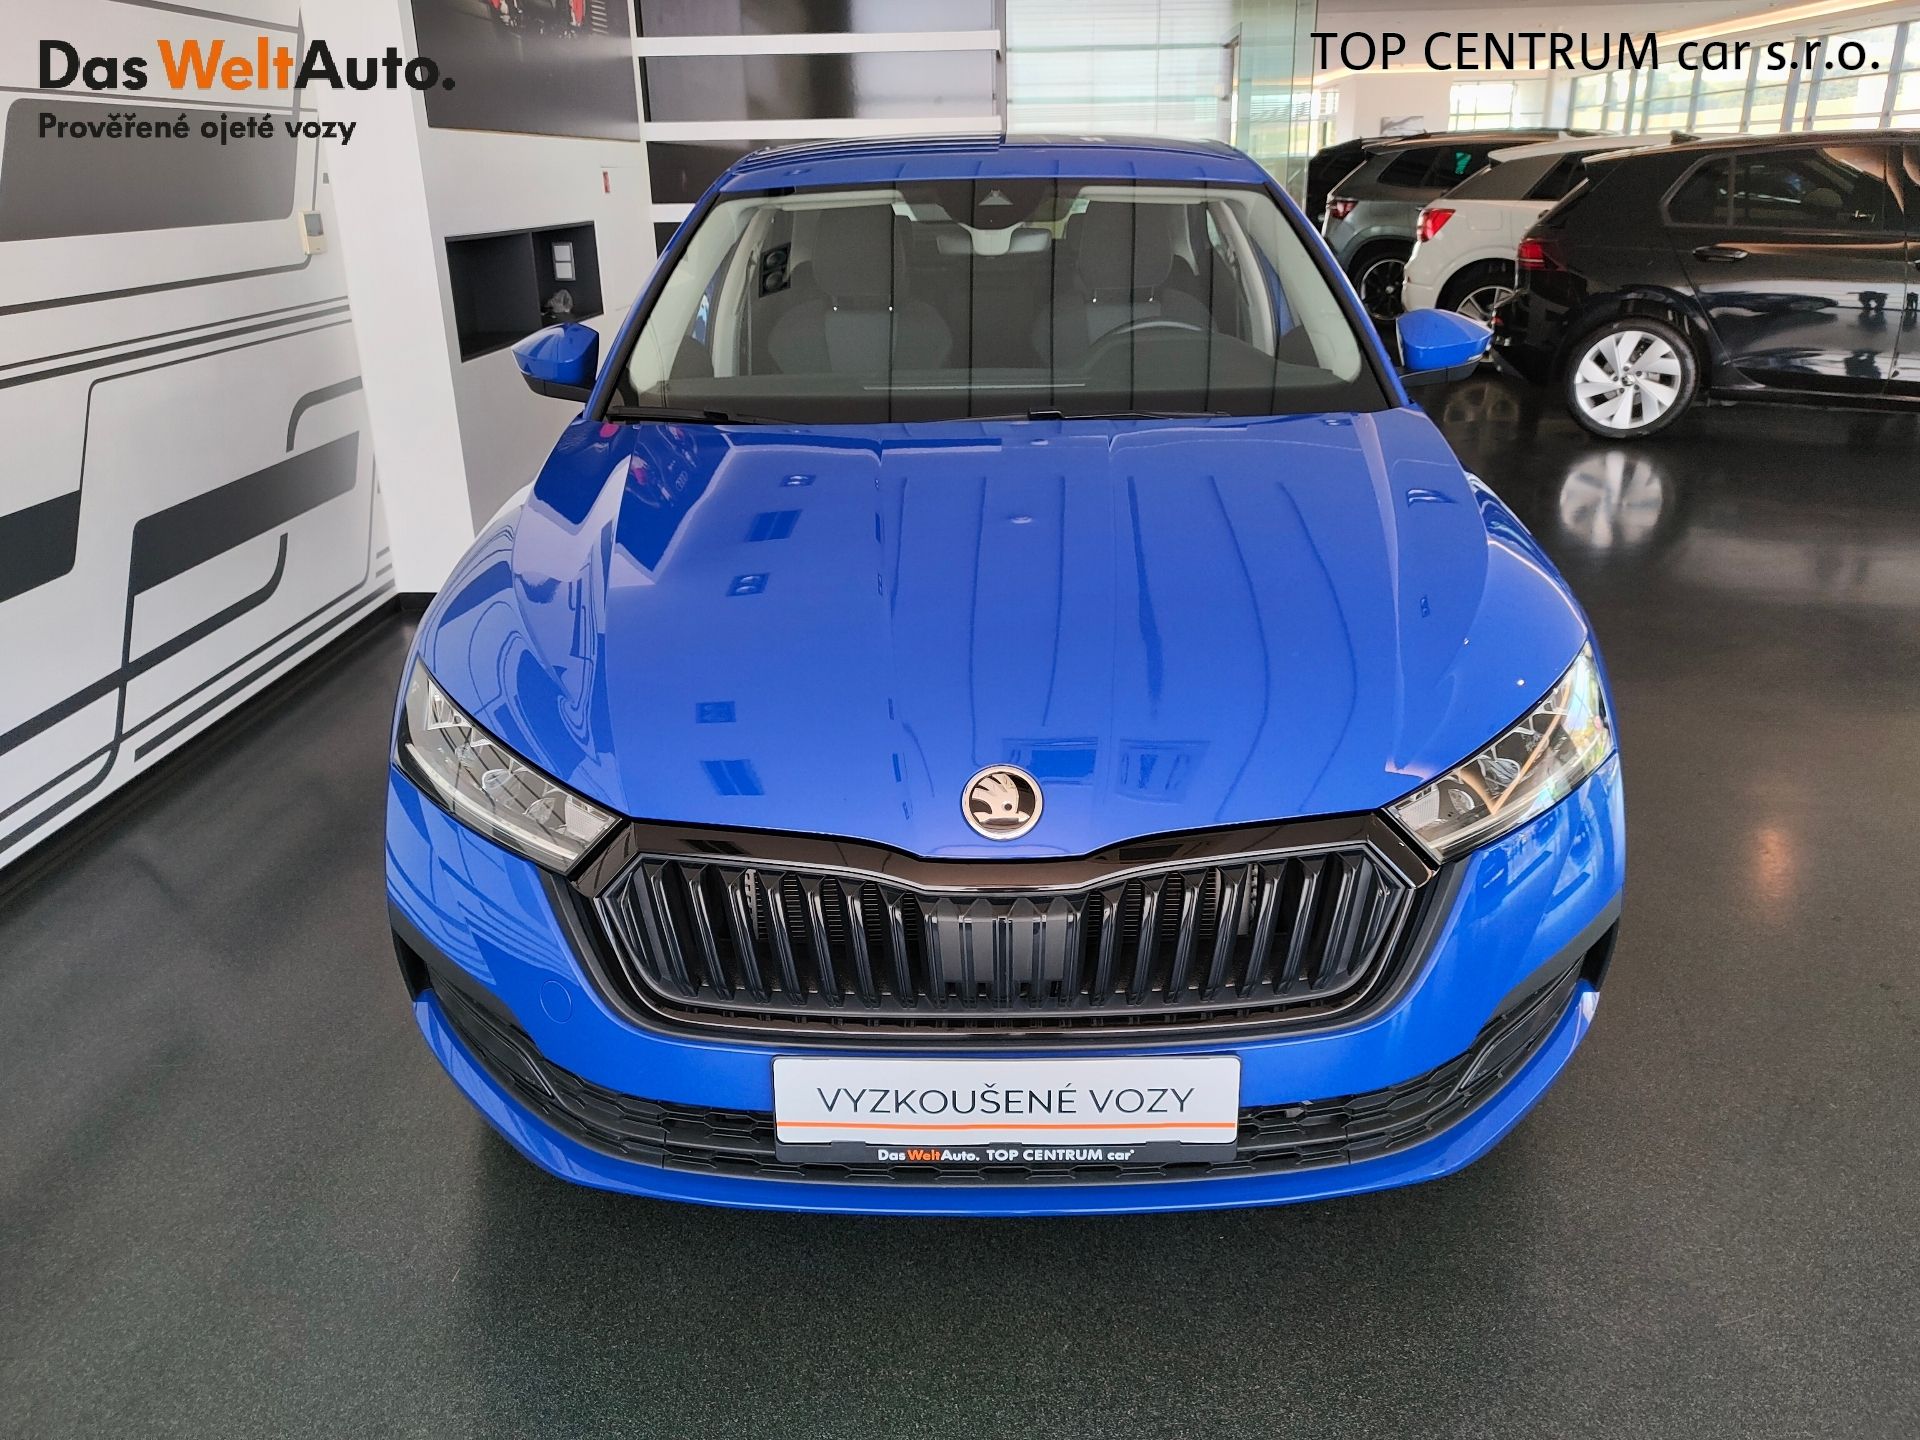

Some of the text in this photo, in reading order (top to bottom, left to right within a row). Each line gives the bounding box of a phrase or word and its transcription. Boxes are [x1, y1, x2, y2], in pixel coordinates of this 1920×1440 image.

[816, 1082, 1196, 1115] VYZKOUŠENÉ VOZY
[877, 1149, 906, 1161] Das
[907, 1148, 980, 1161] WeltAuto.
[986, 1149, 1019, 1161] TOP
[1022, 1149, 1103, 1161] CENTRUM
